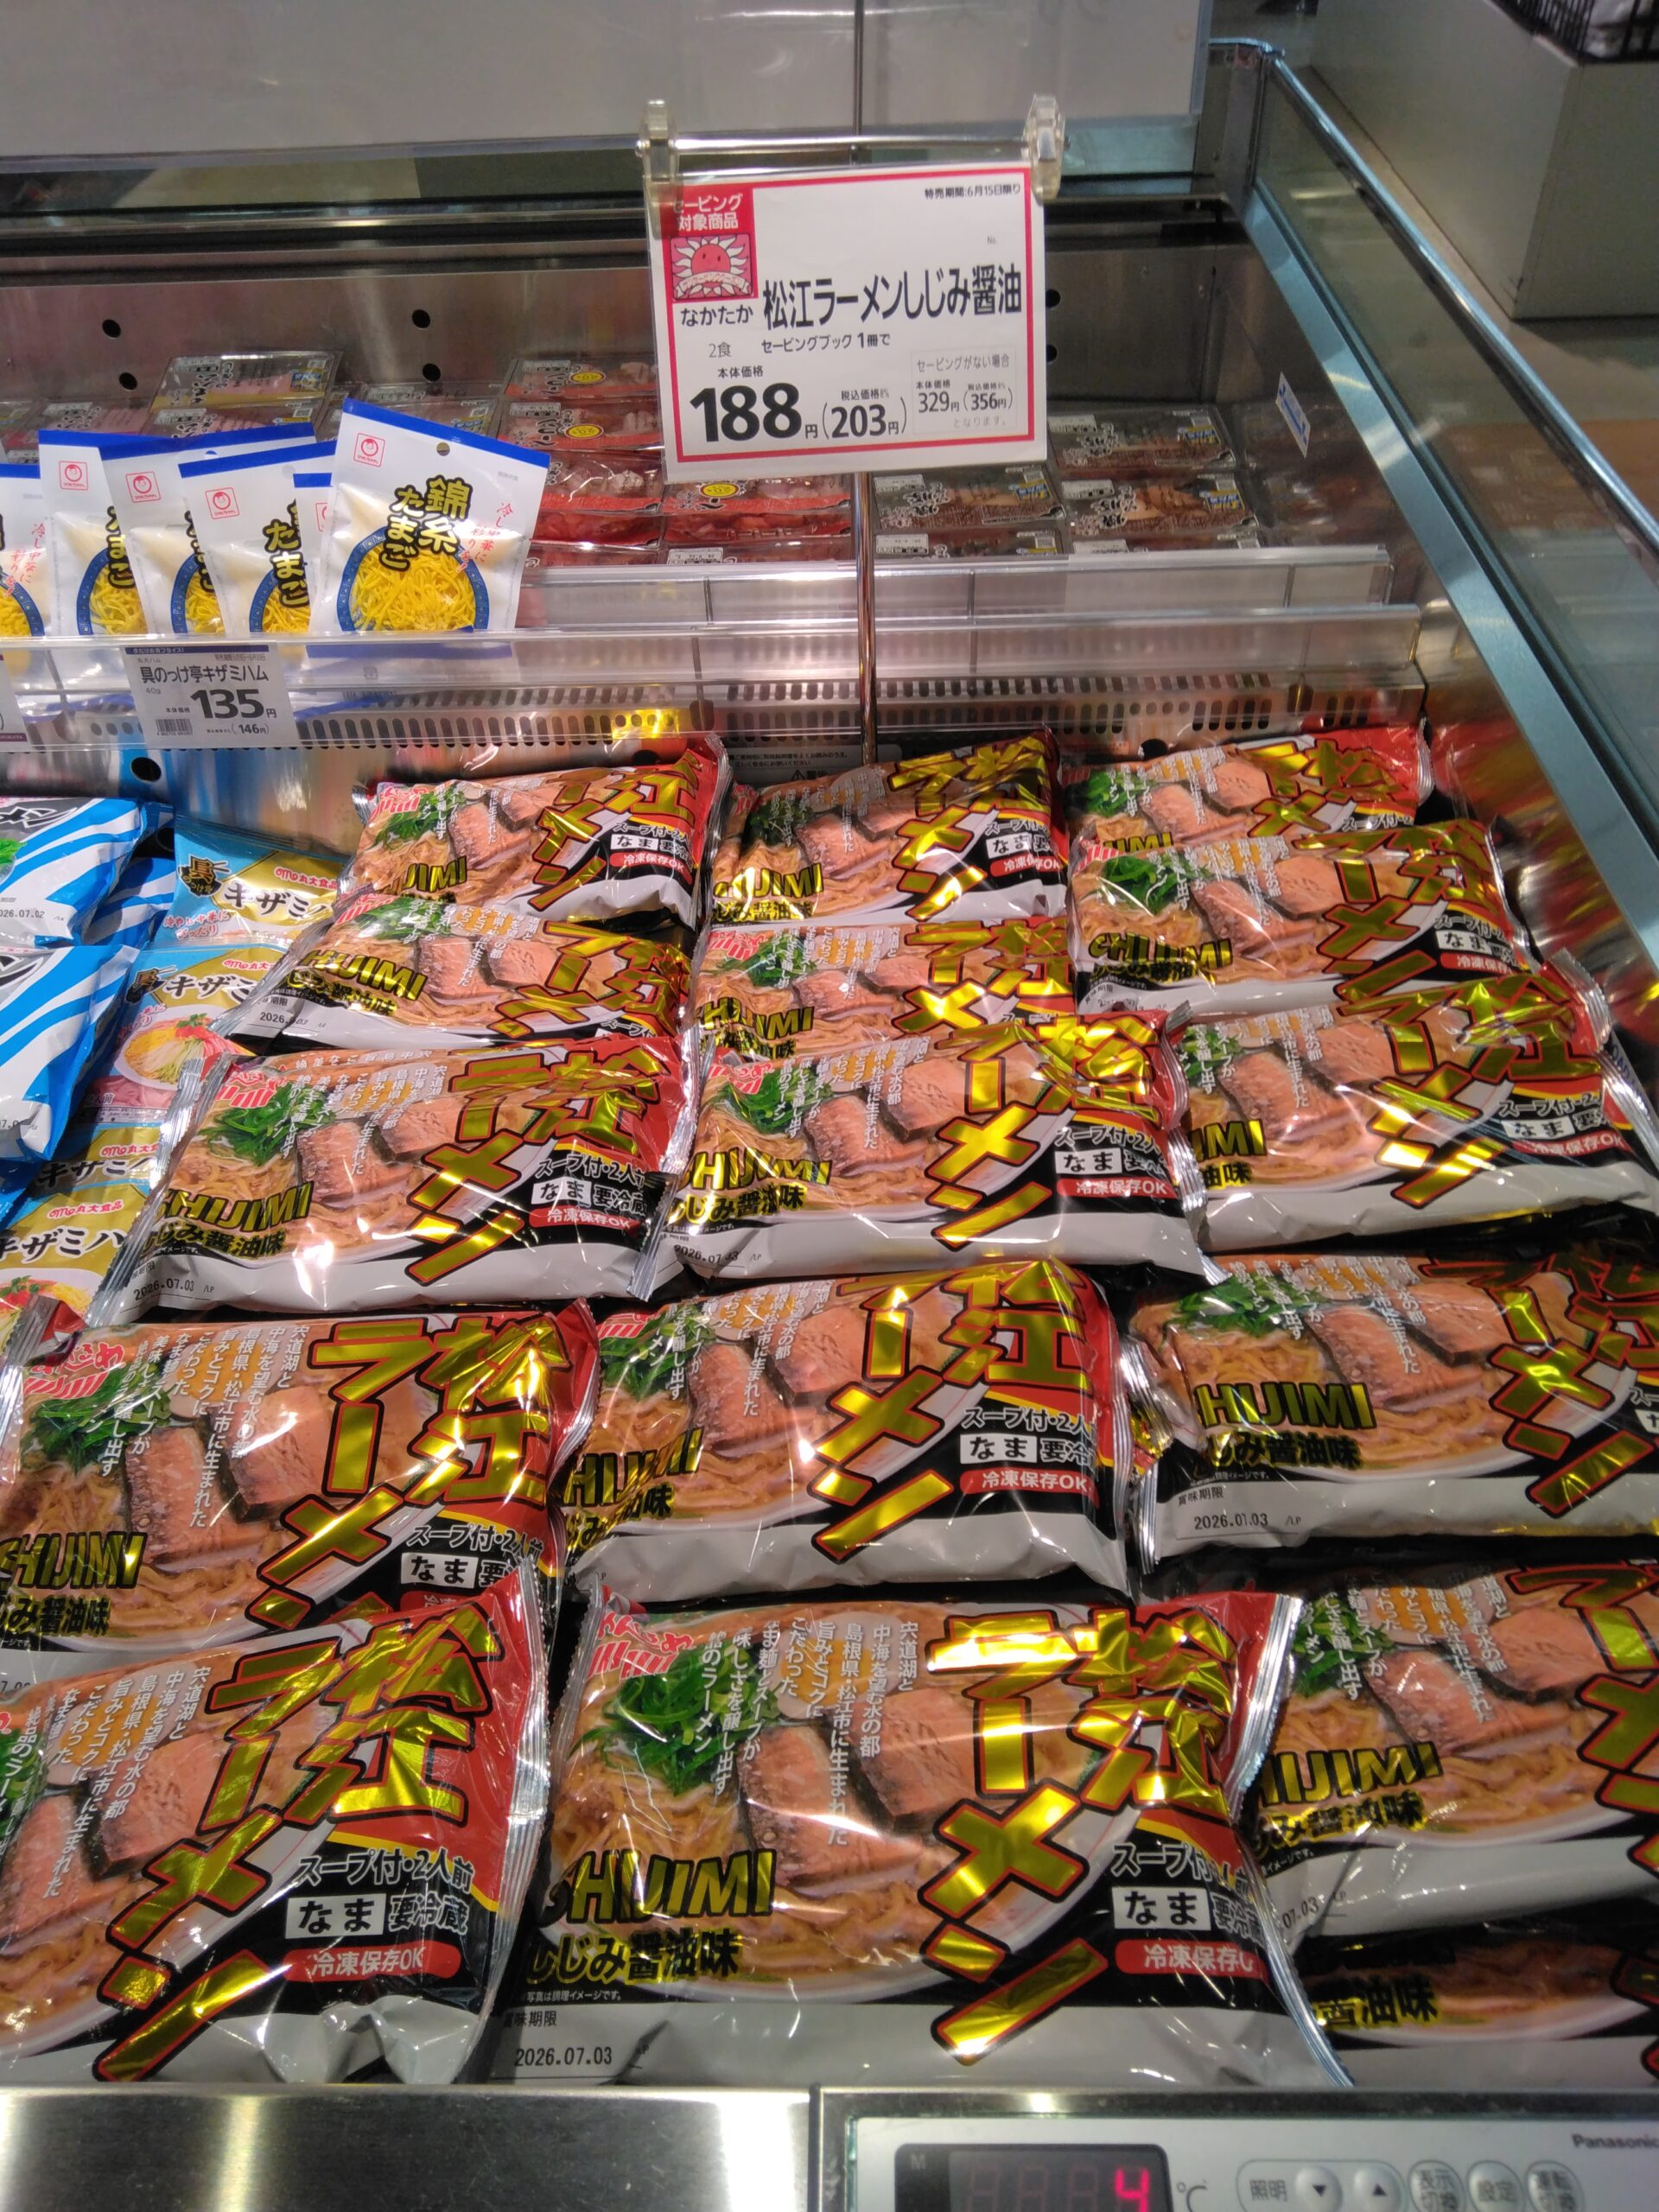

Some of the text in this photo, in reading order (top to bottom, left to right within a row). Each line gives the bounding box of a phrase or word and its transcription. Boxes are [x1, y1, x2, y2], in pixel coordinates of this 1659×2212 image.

[678, 213, 739, 231] 対象商品
[681, 304, 754, 327] なかたか
[762, 264, 1022, 331] 松江ラーメンしじみ醤油
[709, 341, 732, 359] 2食
[761, 334, 852, 353] セービングブック
[717, 365, 764, 378] 本体価格
[917, 353, 1010, 372] セービングがない場合
[916, 379, 950, 390] 本体価格
[379, 485, 425, 572] たまご
[418, 474, 473, 554] 錦糸
[141, 664, 269, 683] 具のっけ亭キザミハム
[617, 836, 652, 849] なま
[623, 853, 684, 872] 冷凍保存OK
[1445, 932, 1485, 951] なま
[1514, 1121, 1565, 1137] なま
[126, 1145, 158, 1154] 丸大食
[1064, 1152, 1115, 1173] なま
[681, 1147, 832, 1190] HIJIMI
[541, 1180, 585, 1201] なま
[1077, 1180, 1167, 1196] 冷凍保存OK
[162, 1180, 315, 1233] HIJIMI
[547, 1209, 631, 1228] 冷凍保存OK
[133, 1278, 195, 1301] 2026.07.03
[172, 1332, 214, 1396] こだわった
[192, 1329, 239, 1415] 旨みとコクに
[276, 1325, 310, 1389] 宍道湖と
[404, 1314, 572, 1506] 松江
[962, 1408, 1092, 1438] スープ付・2人
[1195, 1382, 1376, 1430] HIJIMI
[189, 1329, 261, 1527] 島根県・松江市に生まれた
[969, 1436, 1095, 1465] なま 要冷
[982, 1471, 1089, 1493] 冷凍保存OK
[1178, 1485, 1224, 1506] 賞味期限
[410, 1557, 469, 1584] なま
[0, 1595, 111, 1637] み醤油味
[1401, 1586, 1437, 1644] みとコクに
[779, 1617, 806, 1697] こだわった
[805, 1621, 836, 1719] 旨みとコクに
[899, 1621, 918, 1691] 宍道湖と
[168, 1666, 212, 1741] 宍道湖と
[860, 1624, 891, 1758] 中海を望む水の都
[54, 1685, 106, 1764] こだわった
[72, 1678, 133, 1783] 旨みとコクに
[283, 1601, 504, 1829] 松江
[1063, 1605, 1238, 1821] 松江
[104, 1670, 185, 1820] 中海を望む水の都
[43, 1675, 158, 1898] 島根県・松江市に生まれた
[918, 1609, 1109, 2067] ラーメン
[92, 1639, 347, 2081] ラーメン
[297, 1848, 474, 1895] スープ付・2人前
[298, 1897, 469, 1936] なま 要冷蔵
[1125, 1890, 1197, 1926] なま
[311, 1944, 424, 1978] 冷凍保存OK
[527, 1990, 621, 2003] 写真は調理イメージです。
[514, 2046, 613, 2067] 2026.07.03
[1573, 2134, 1659, 2150] Panasonic
[1249, 2180, 1288, 2202] 照明
